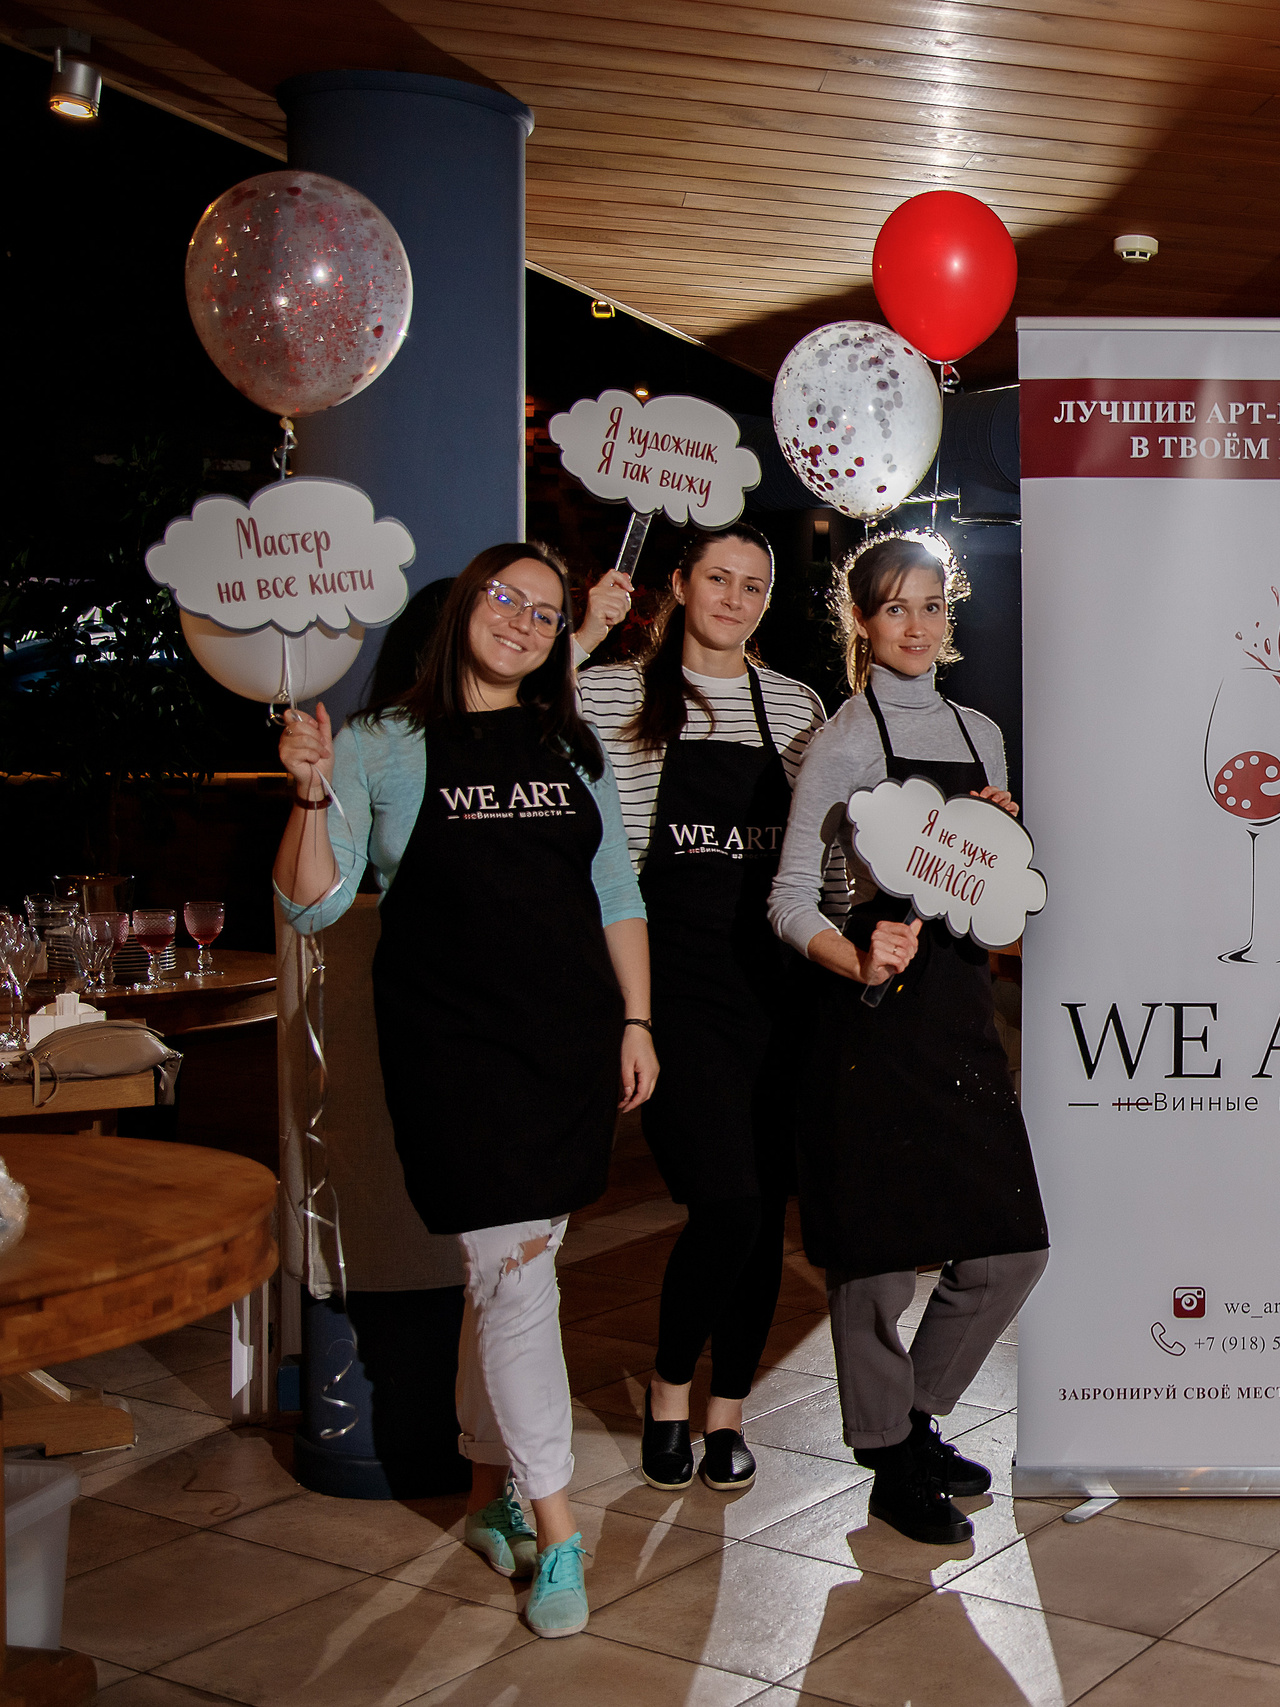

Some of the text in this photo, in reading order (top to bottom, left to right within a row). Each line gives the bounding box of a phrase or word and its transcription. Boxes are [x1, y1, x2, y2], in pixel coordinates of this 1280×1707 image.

[1053, 400, 1196, 425] ЛУЧШИЕ
[605, 406, 718, 464] Я художник,
[1130, 436, 1150, 458] В
[1158, 432, 1270, 460] ТВОЁМ
[597, 441, 711, 508] Я так вижу
[236, 517, 331, 569] Мастер
[217, 569, 375, 604] на все кисти
[439, 781, 571, 811] WE ART
[668, 824, 783, 850] WE ART
[921, 809, 998, 869] Я не хуже
[906, 845, 985, 906] ПИКАССО
[1061, 1002, 1222, 1080] WE
[1112, 1092, 1259, 1112] неВинные
[1194, 1336, 1215, 1350] +7
[1221, 1336, 1266, 1353] (918)
[1058, 1384, 1177, 1401] ЗАБРОНИРУЙ
[1183, 1384, 1231, 1400] СВОЁ
